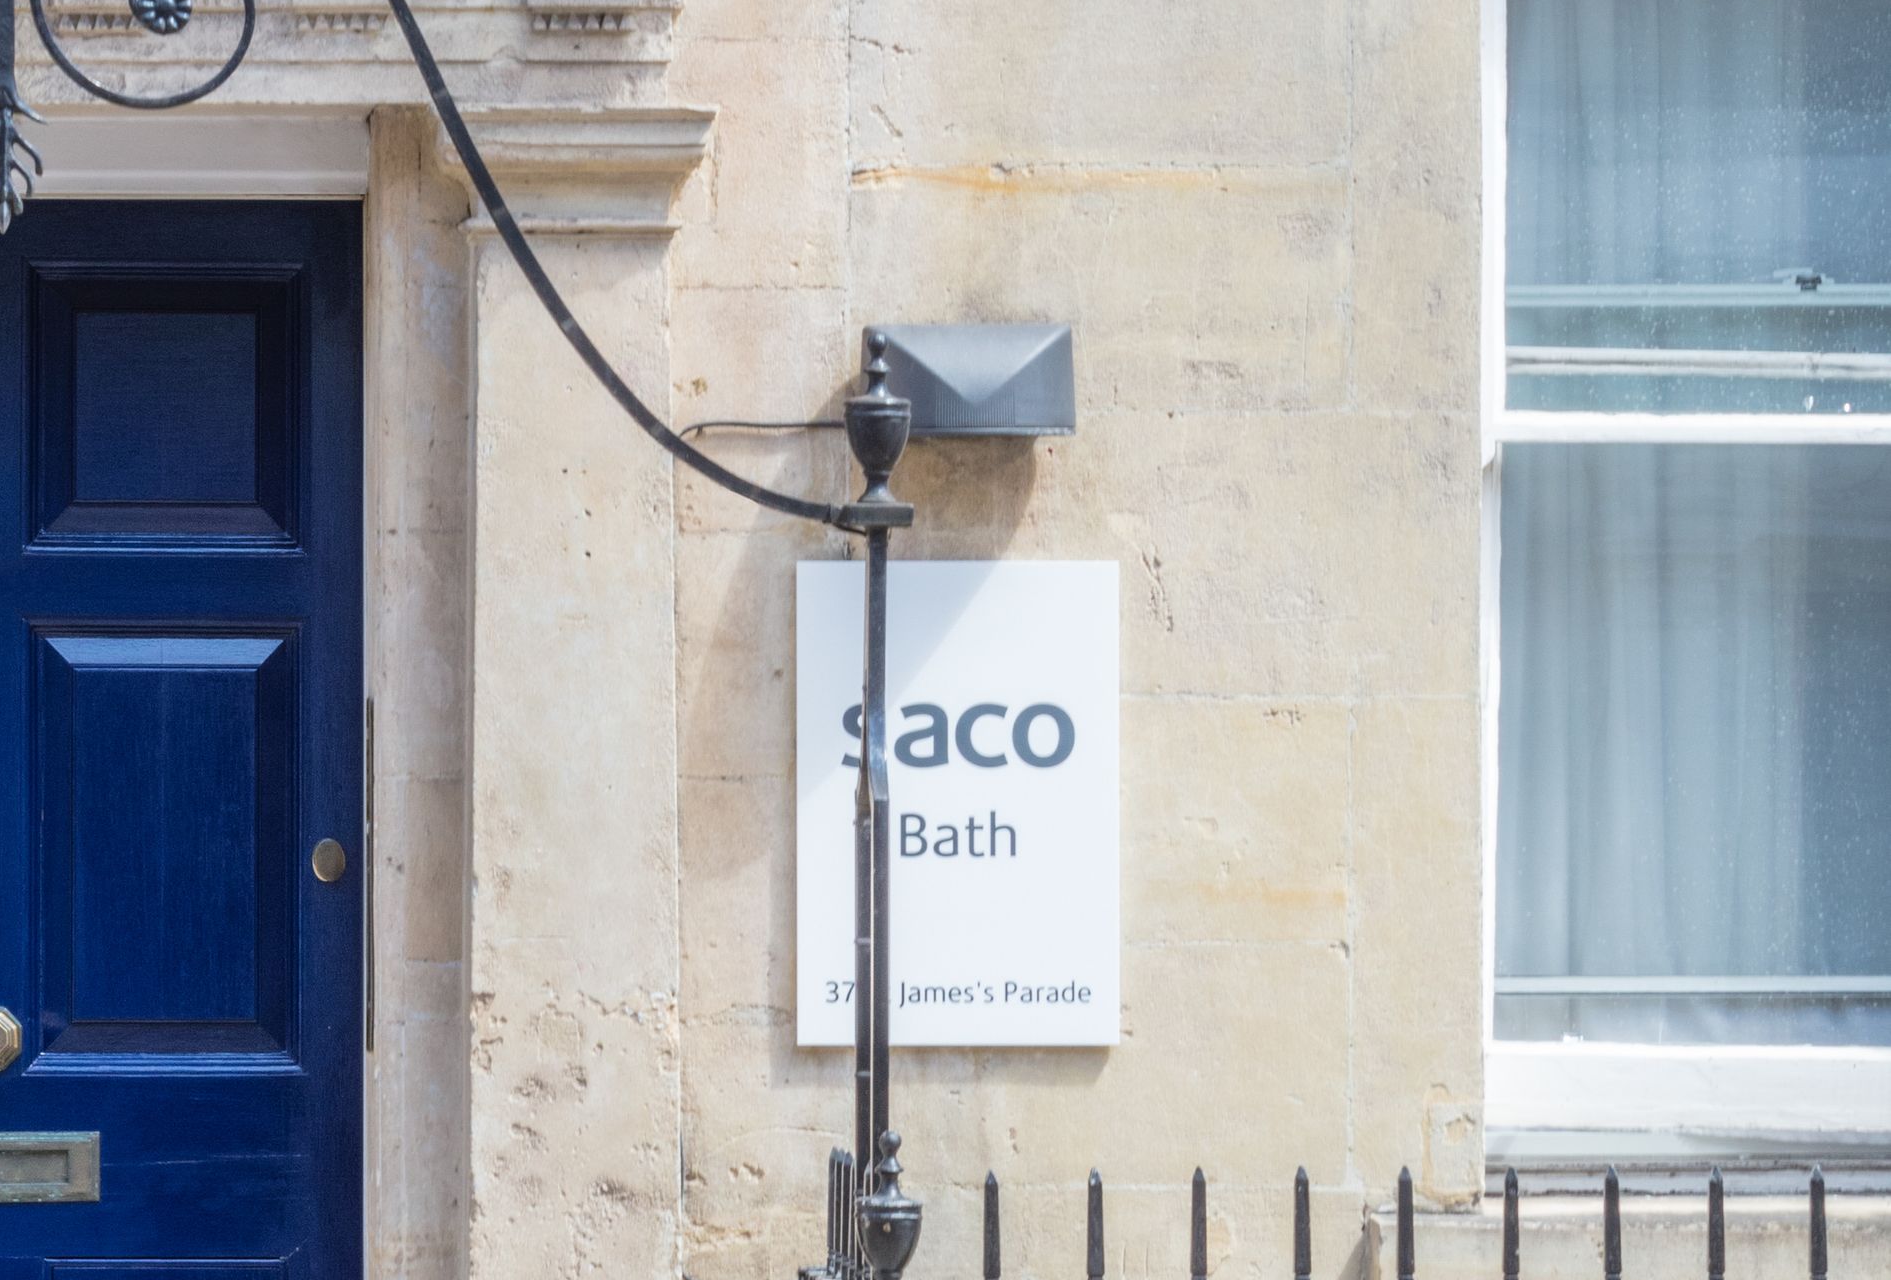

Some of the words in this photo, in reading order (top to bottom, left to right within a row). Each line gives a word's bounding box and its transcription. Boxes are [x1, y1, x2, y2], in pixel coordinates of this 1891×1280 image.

[899, 810, 1017, 858] Bath
[825, 981, 855, 1004] 37
[899, 981, 995, 1009] James's
[1004, 981, 1093, 1004] Parade
